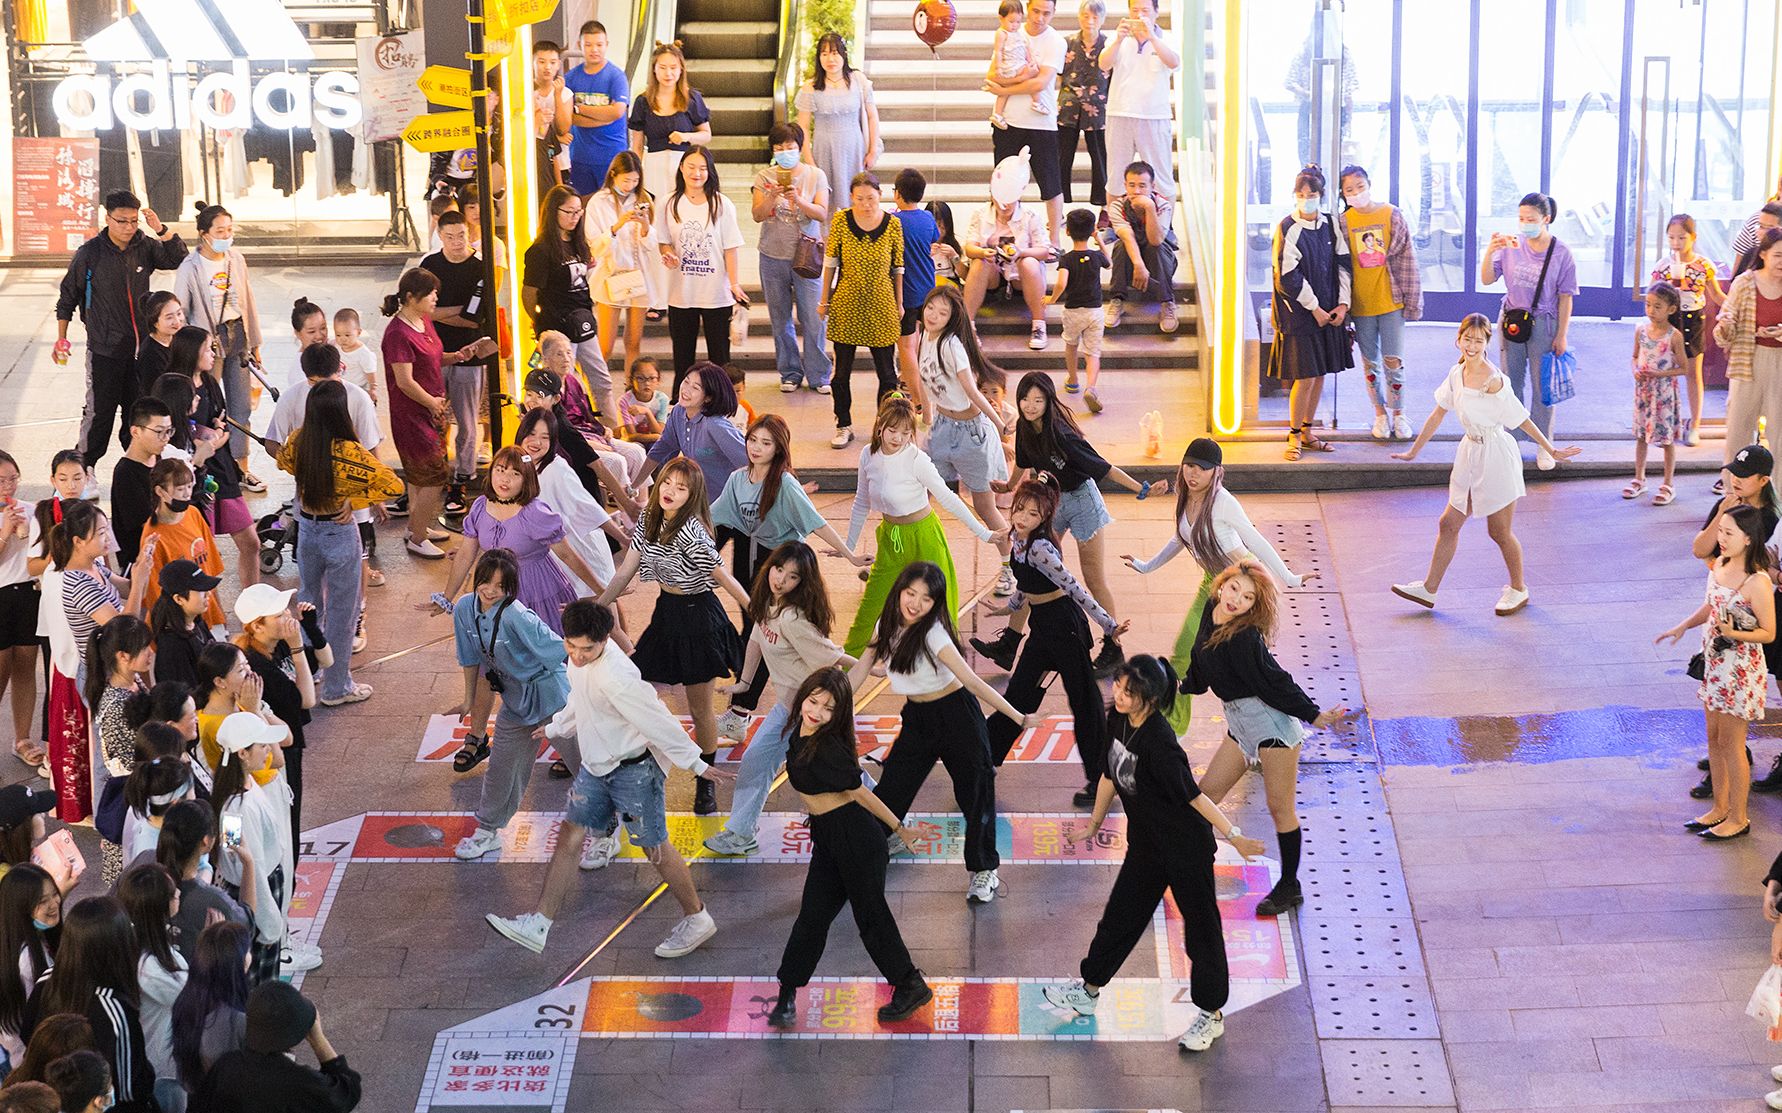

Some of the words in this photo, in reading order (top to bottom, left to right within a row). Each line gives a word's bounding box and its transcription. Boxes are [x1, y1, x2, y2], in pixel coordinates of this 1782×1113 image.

[52, 58, 363, 131] adidas
[682, 256, 710, 266] Sound
[686, 265, 716, 273] nature
[781, 821, 812, 855] 49元
[1033, 821, 1059, 856] 139元
[534, 1004, 576, 1029] 32
[823, 986, 857, 1029] 99元
[933, 984, 960, 1032] 后退五格
[452, 1050, 554, 1062] (前进一格)
